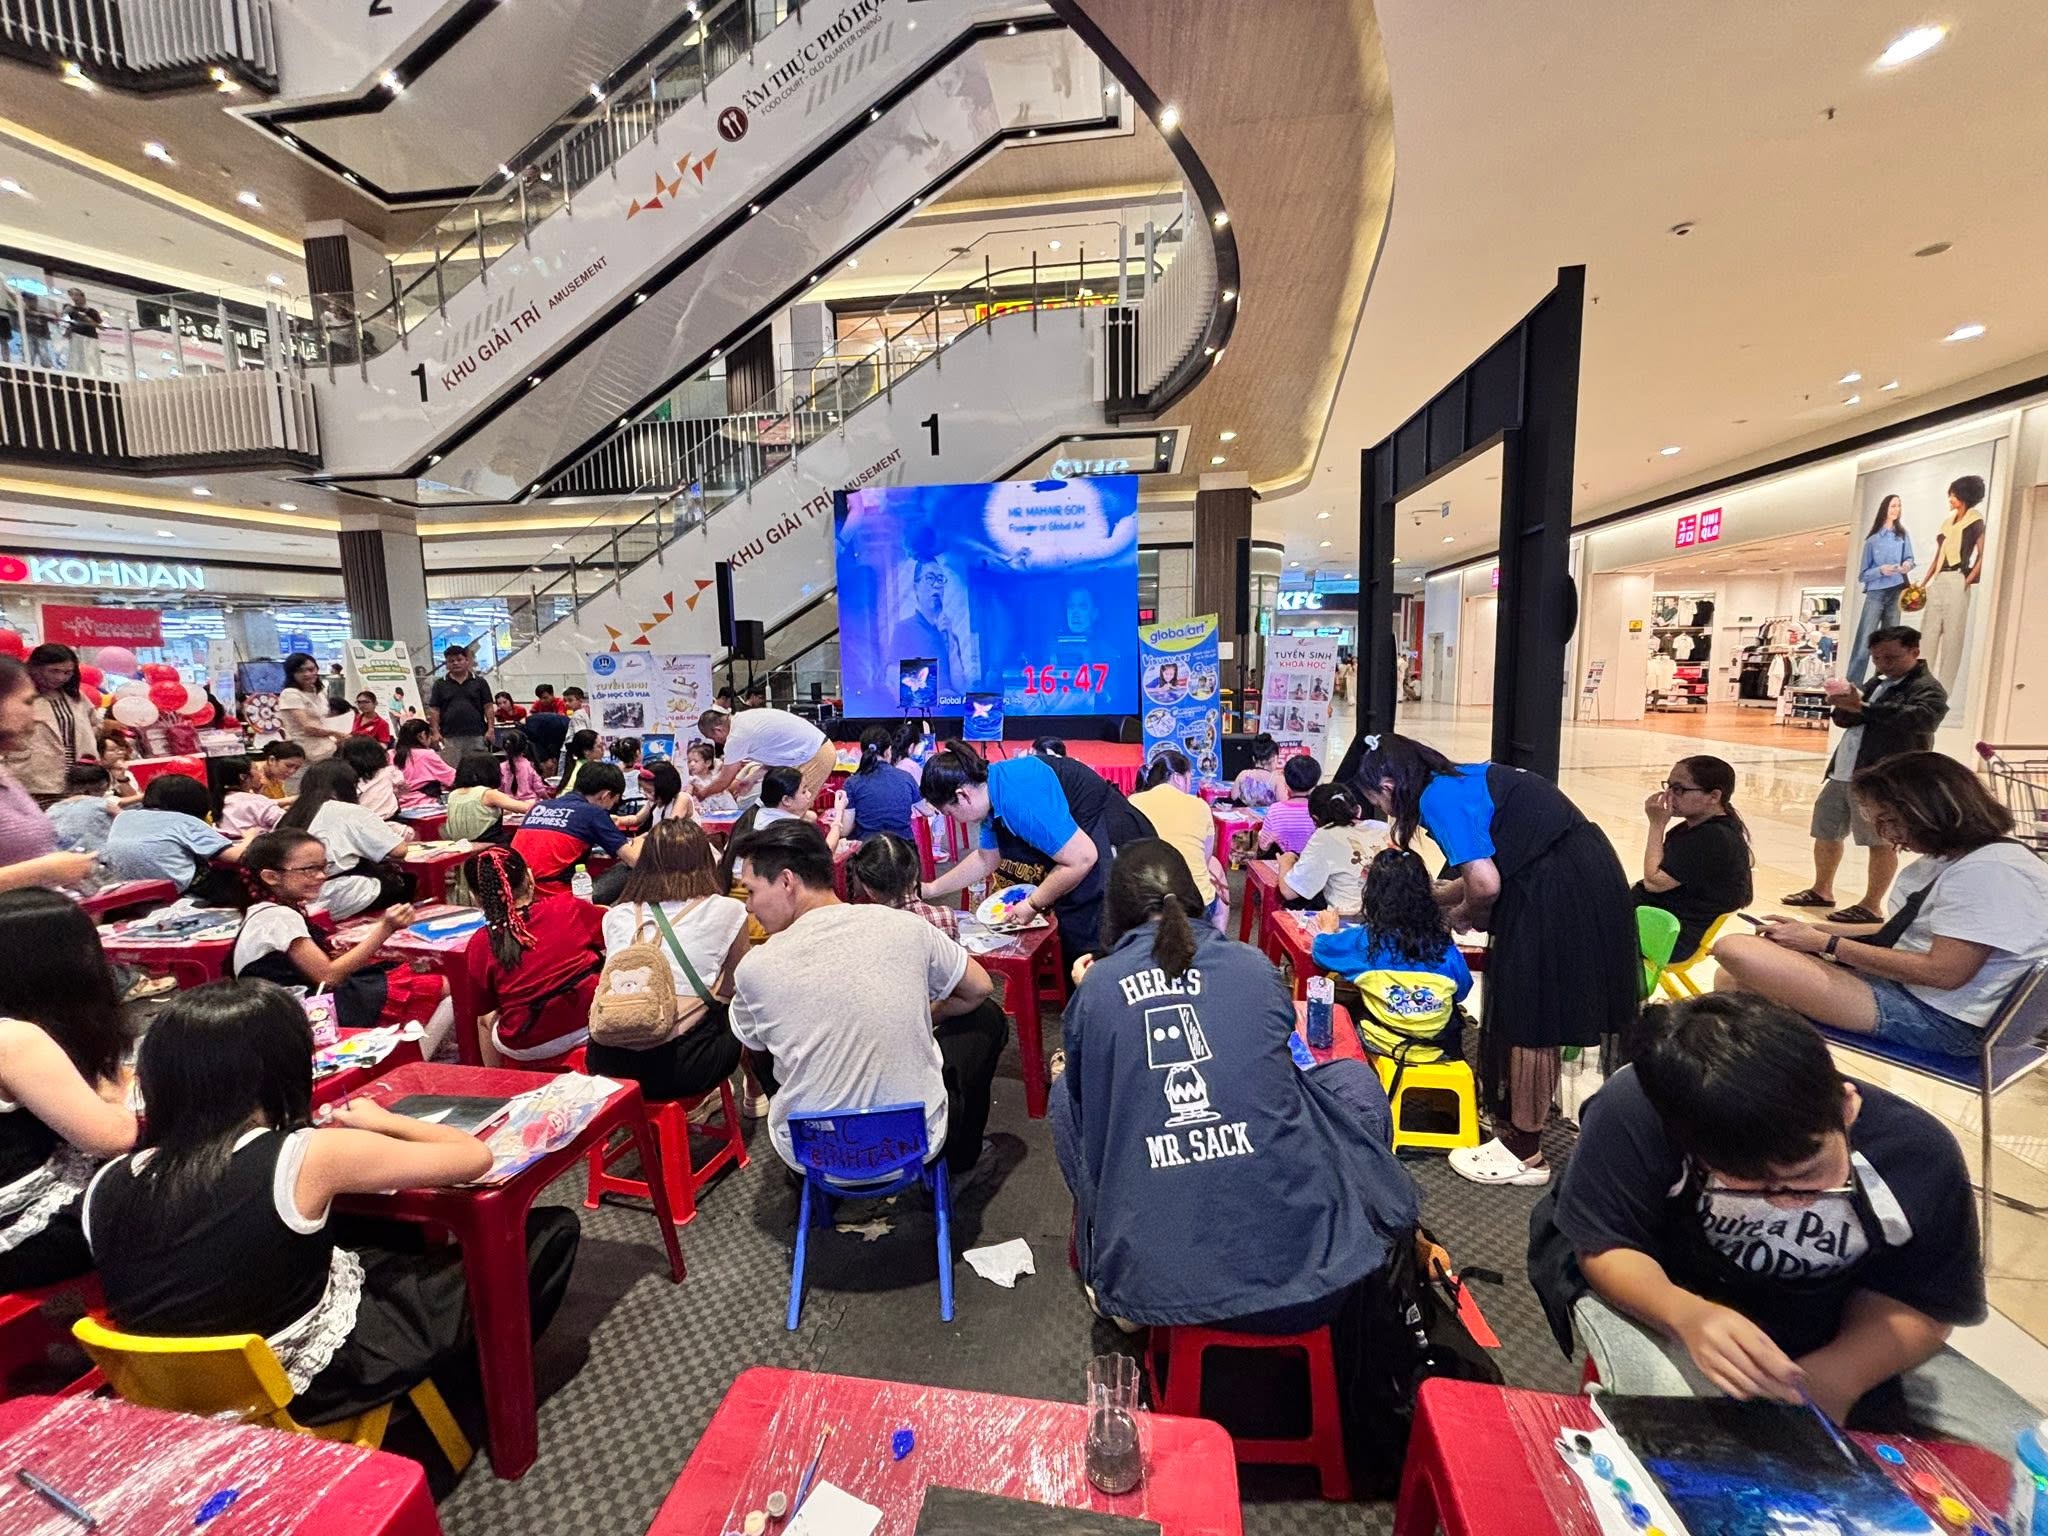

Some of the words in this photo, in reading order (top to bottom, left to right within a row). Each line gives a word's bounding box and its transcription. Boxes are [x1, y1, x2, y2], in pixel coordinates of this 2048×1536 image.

[761, 96, 781, 116] FOOD
[781, 78, 805, 100] COURT
[810, 62, 824, 77] OLD
[825, 38, 857, 65] QUARTER
[857, 14, 882, 39] DINING
[548, 256, 608, 310] AMUSEMENT
[441, 356, 478, 391] KHU
[478, 328, 512, 361] GIẢI
[511, 300, 542, 334] TRÍ
[411, 363, 428, 402] 1
[921, 413, 940, 456] 1
[844, 448, 902, 492] MUSEMENT
[727, 538, 765, 572] KHU
[766, 512, 803, 545] GIẢI
[802, 486, 835, 520] TRÍ
[29, 556, 206, 591] KOHNAN
[1277, 591, 1323, 610] KFC
[1309, 651, 1332, 660] SINH
[1024, 664, 1109, 694] 16:47
[525, 816, 568, 828] EXPRESS
[543, 808, 575, 818] BEST
[1146, 1132, 1191, 1169] MR.
[1189, 1121, 1254, 1162] SACK
[1796, 1210, 1852, 1261] Pal
